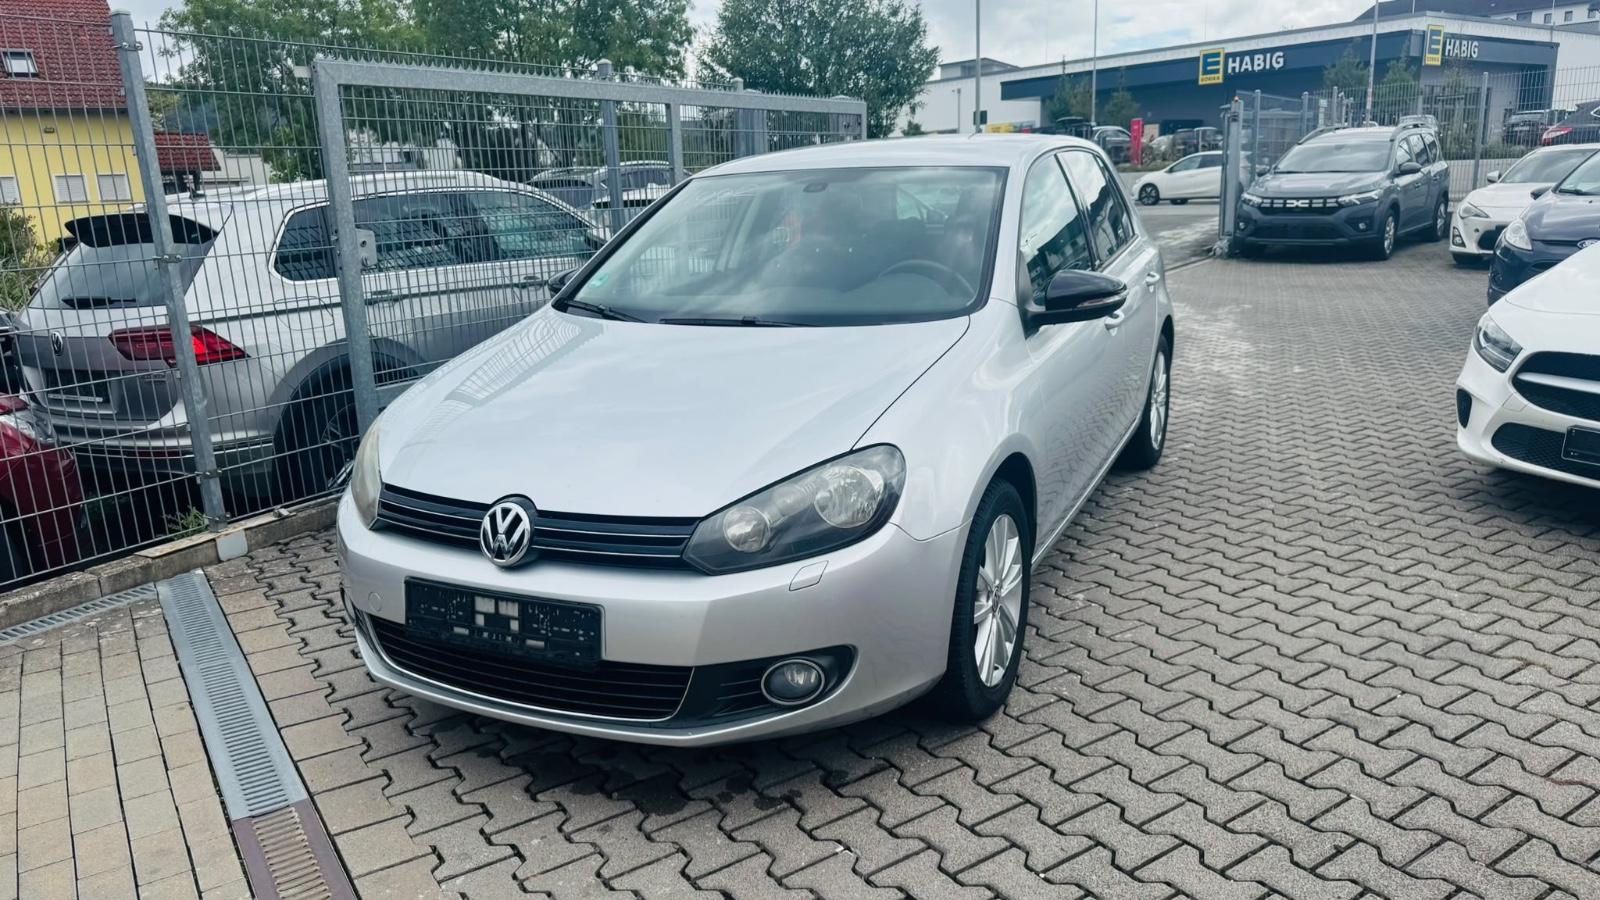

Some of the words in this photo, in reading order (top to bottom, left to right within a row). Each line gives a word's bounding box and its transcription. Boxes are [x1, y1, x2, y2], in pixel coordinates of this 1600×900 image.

[1445, 38, 1479, 58] HABIG
[1227, 51, 1284, 74] HABIG
[480, 502, 531, 564] VW
